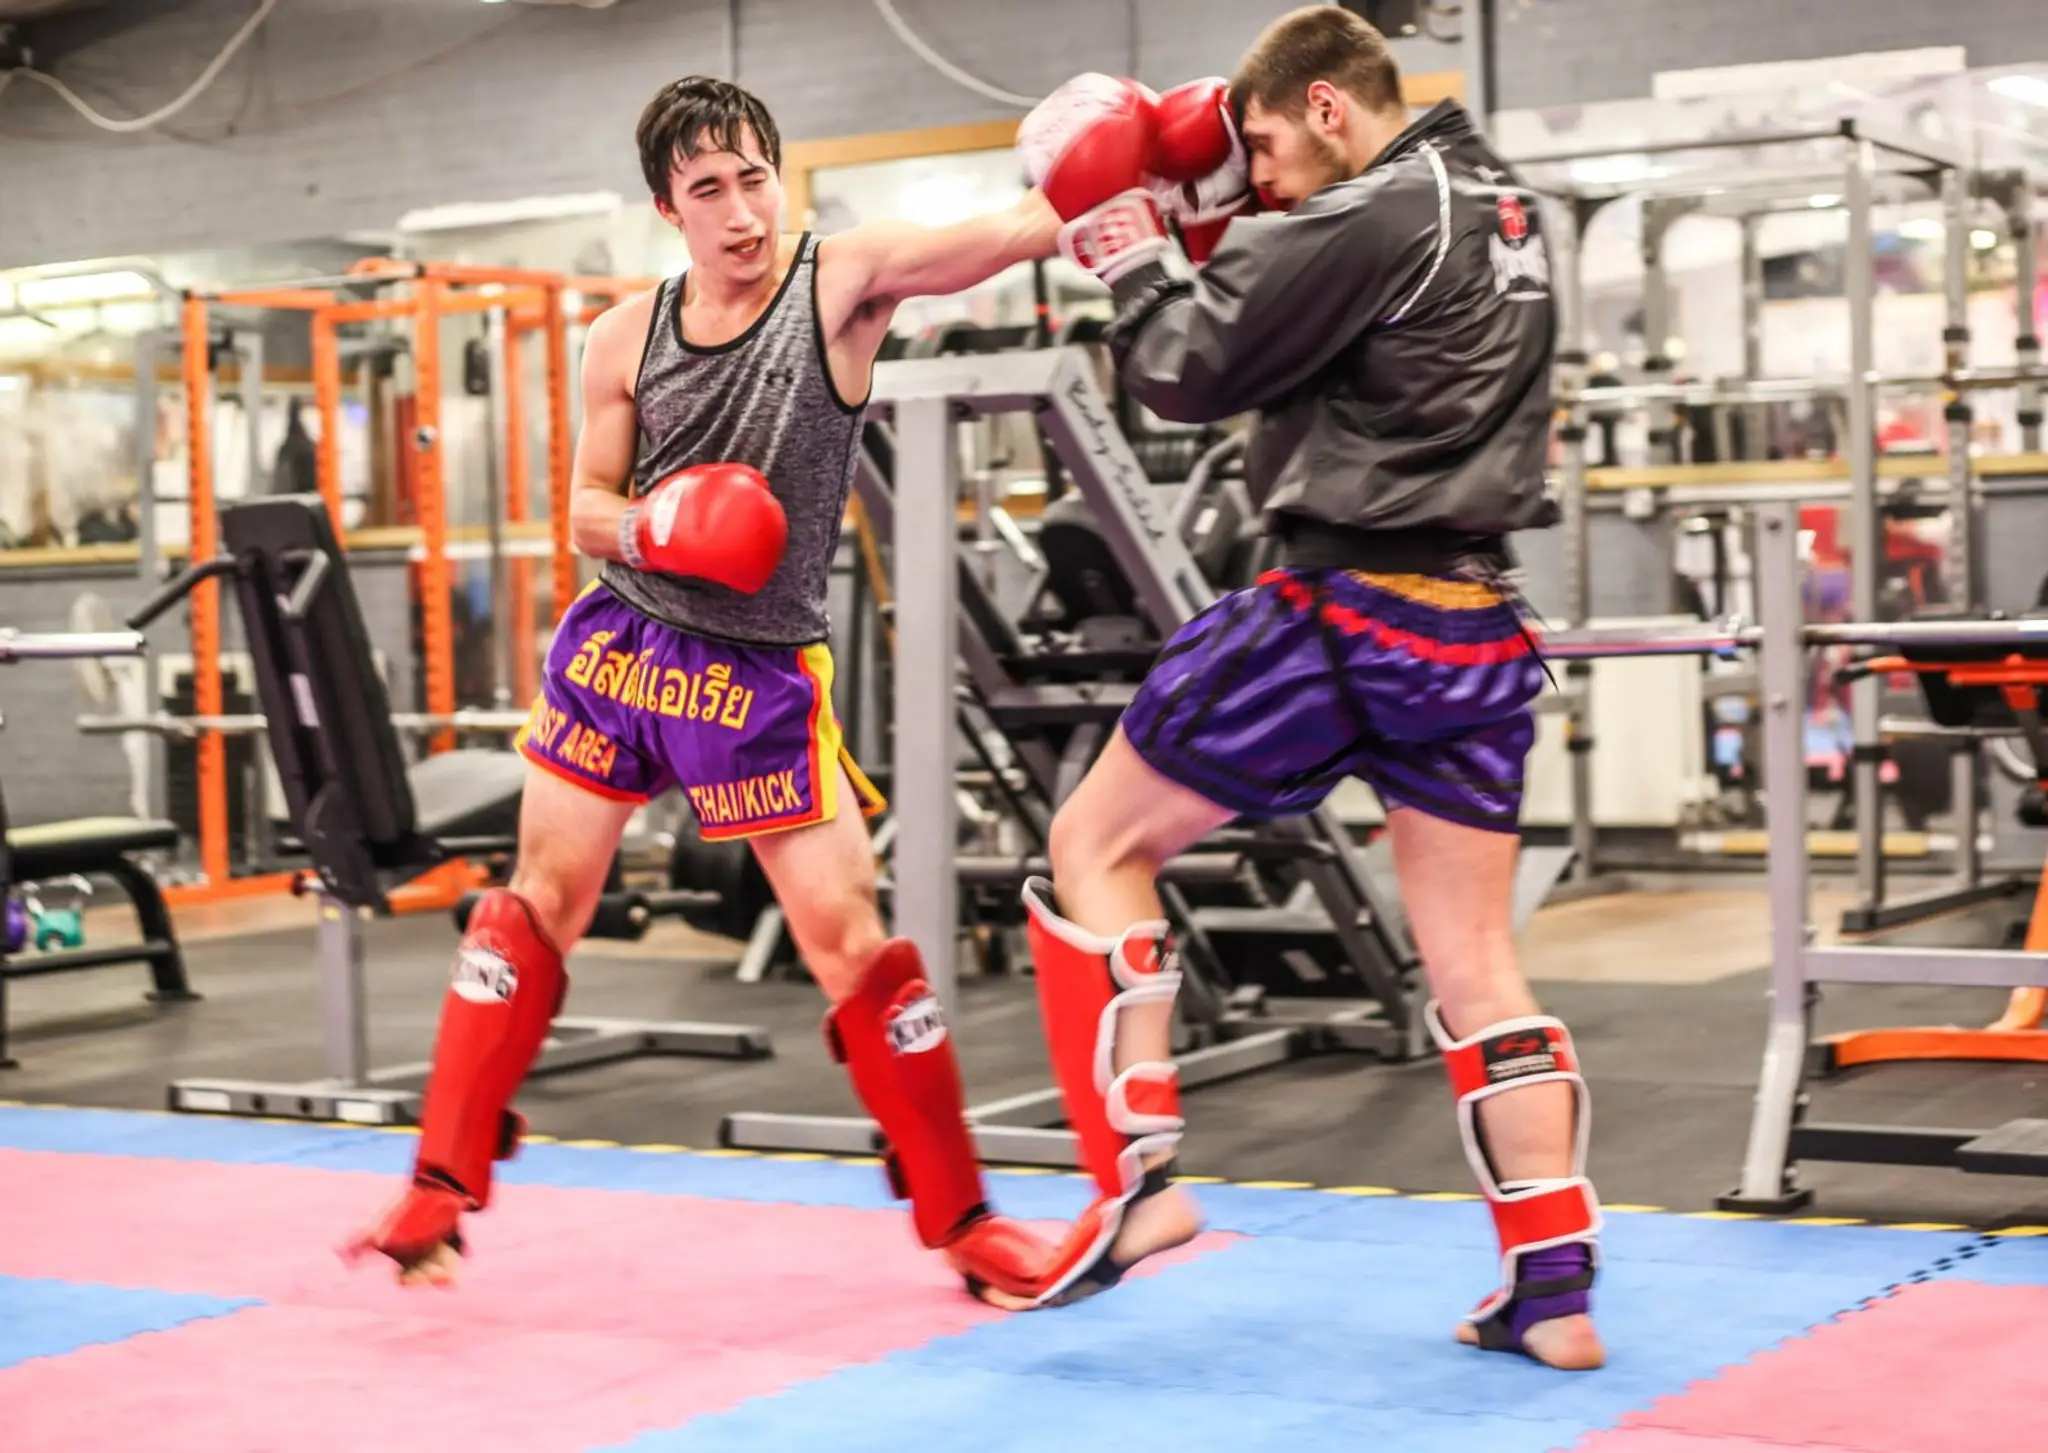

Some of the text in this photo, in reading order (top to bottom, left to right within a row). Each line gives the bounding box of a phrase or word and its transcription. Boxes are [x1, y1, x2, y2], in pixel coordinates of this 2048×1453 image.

[556, 720, 616, 778] AREA
[688, 769, 803, 823] THAI/KICK
[891, 1011, 943, 1050] KIN
